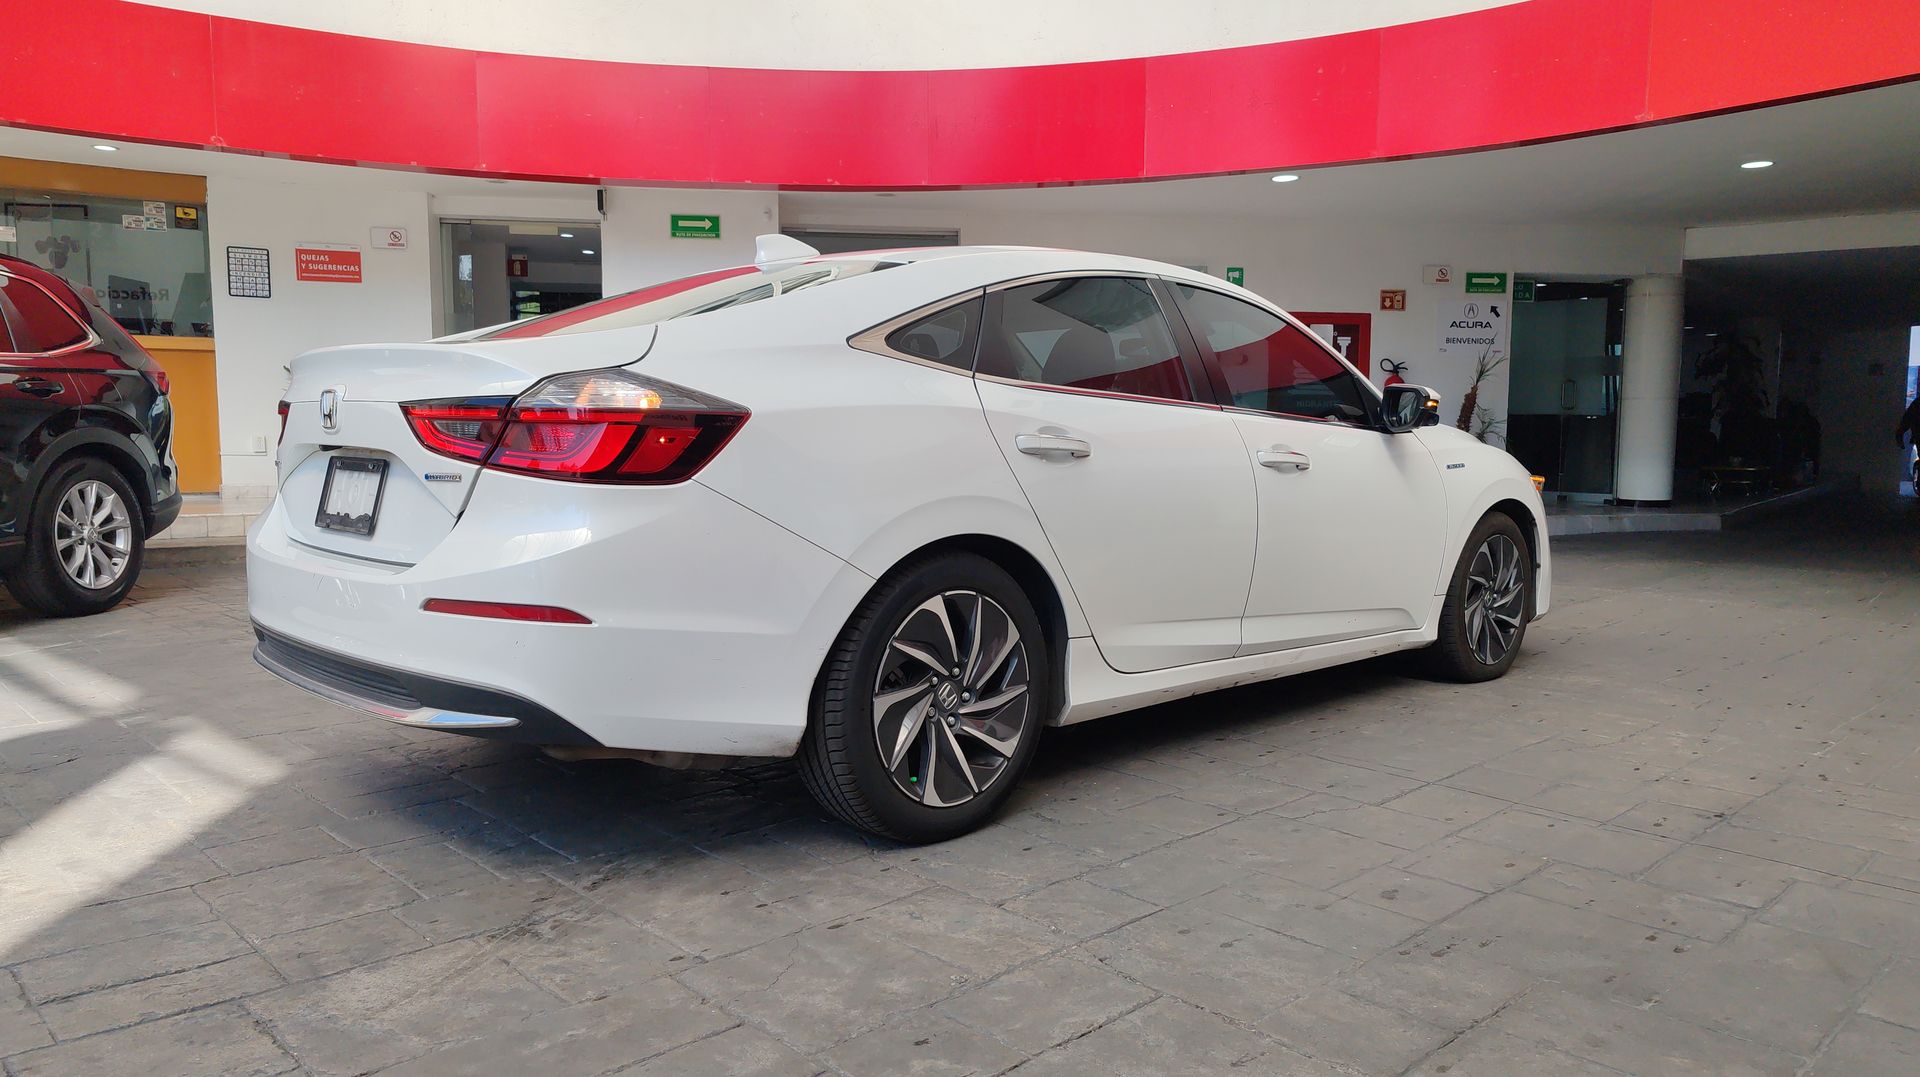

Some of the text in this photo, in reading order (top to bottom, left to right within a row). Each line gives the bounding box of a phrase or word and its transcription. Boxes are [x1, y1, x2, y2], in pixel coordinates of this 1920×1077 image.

[300, 254, 330, 262] QUEJAS
[308, 264, 360, 272] SUGERENCIAS
[1449, 321, 1493, 329] ACURA
[1445, 337, 1496, 345] BIENVENIDOS
